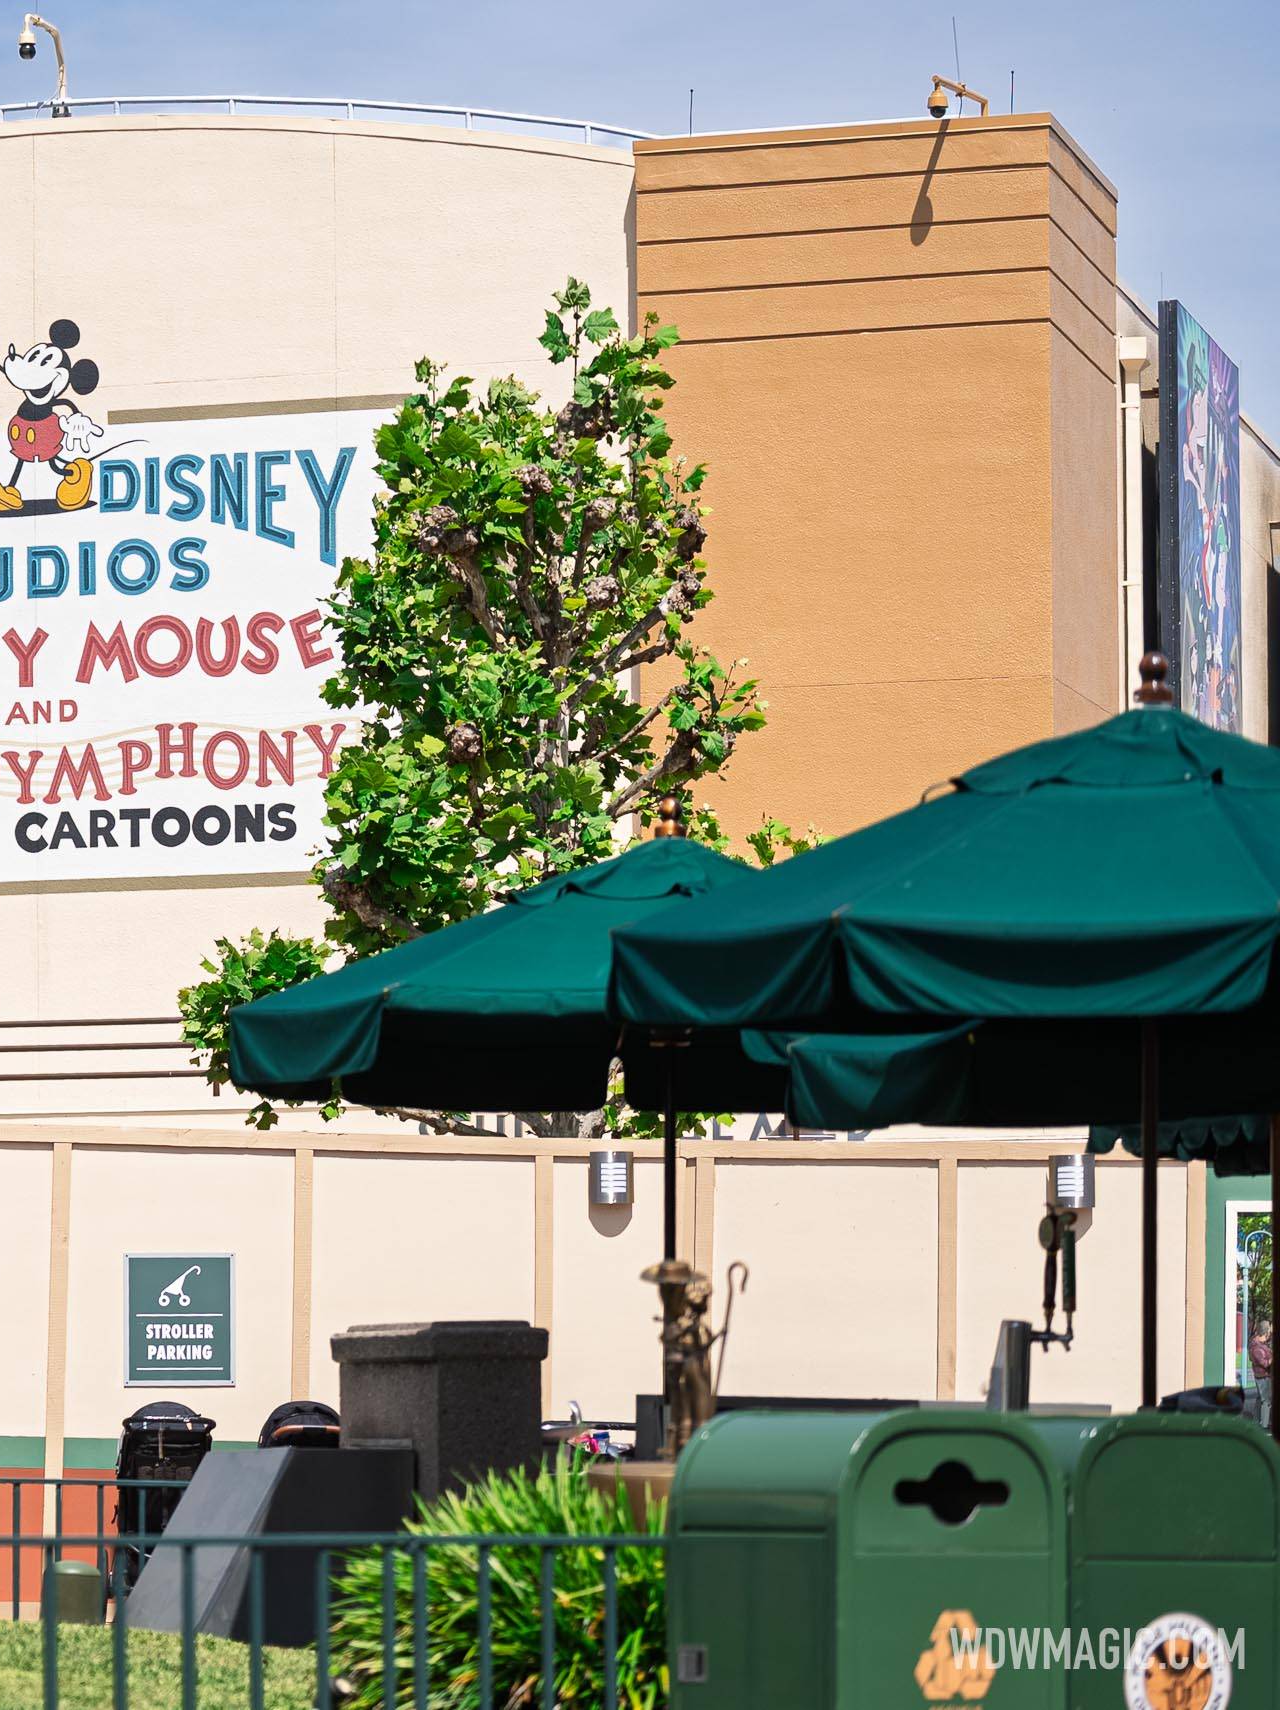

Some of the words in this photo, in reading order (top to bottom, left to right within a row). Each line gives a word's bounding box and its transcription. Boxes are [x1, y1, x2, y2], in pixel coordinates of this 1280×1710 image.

[99, 447, 357, 566] DISNEY
[75, 609, 334, 684] MOUSE
[6, 700, 78, 725] AND
[14, 803, 297, 854] CARTOONS
[146, 1323, 214, 1339] STROLLER
[147, 1344, 213, 1360] PARKING
